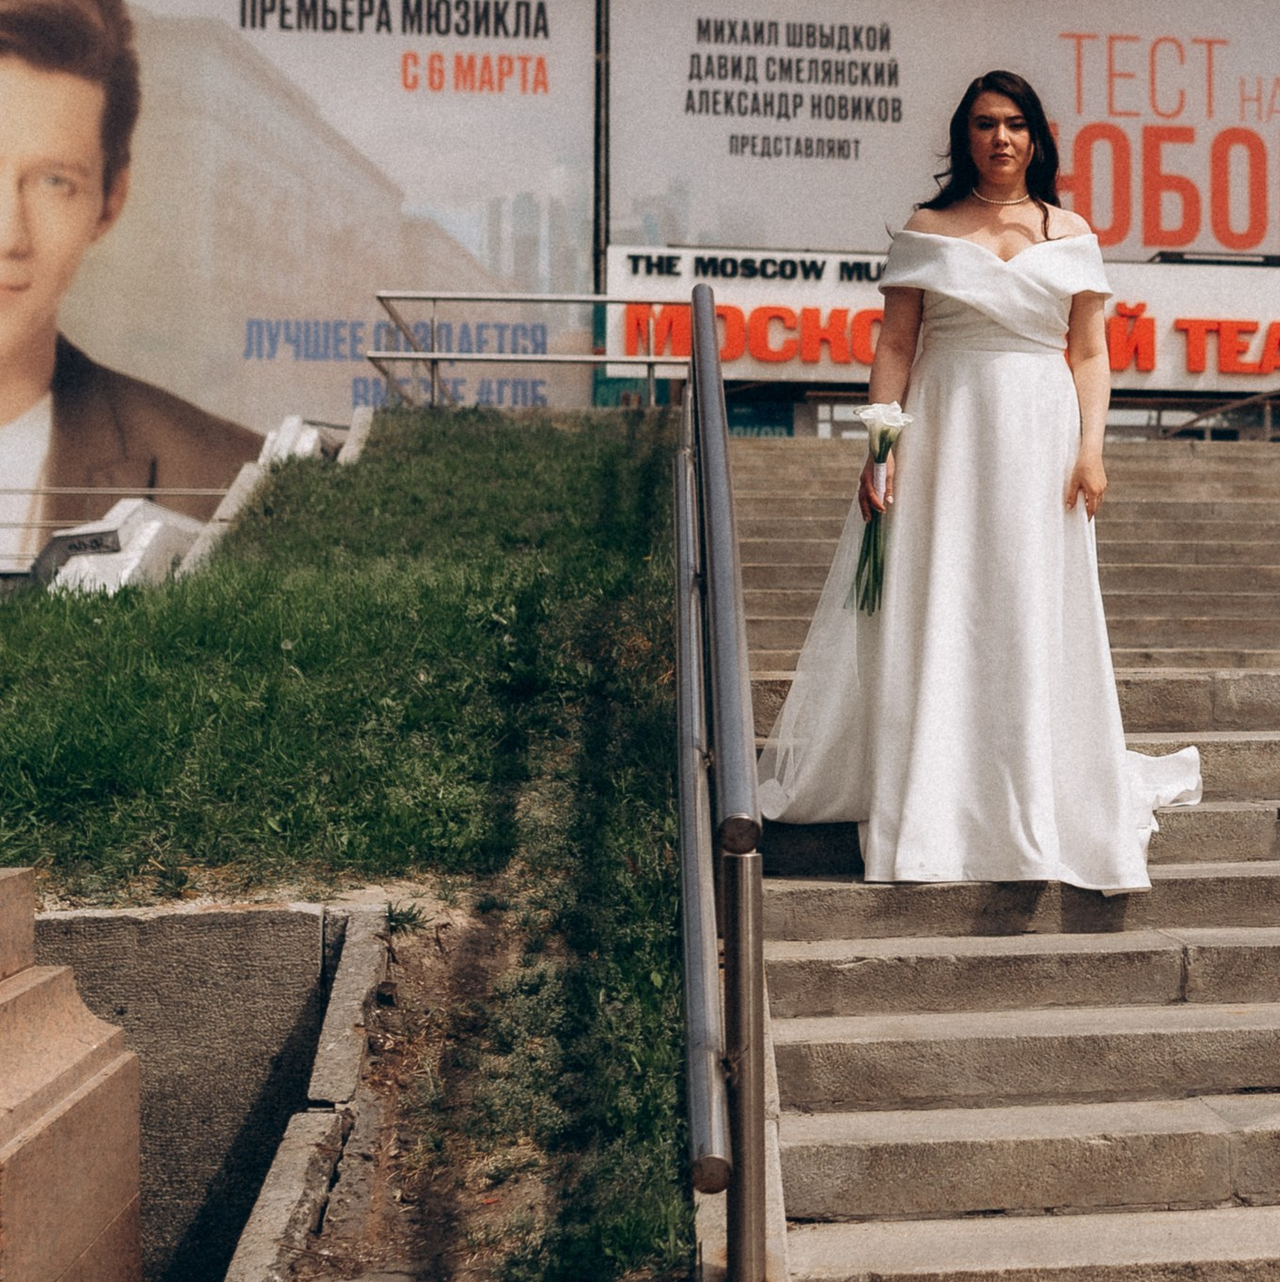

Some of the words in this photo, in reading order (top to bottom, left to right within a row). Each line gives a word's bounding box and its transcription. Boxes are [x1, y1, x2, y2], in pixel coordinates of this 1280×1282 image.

[697, 17, 778, 46] МИХАИЛ
[786, 23, 891, 52] ШВЫДКОЙ
[401, 51, 419, 92] С
[427, 52, 445, 93] 6
[453, 53, 549, 95] МАРТА
[688, 54, 758, 84] ДАВИД
[765, 56, 899, 87] СМЕЛЯНСКИЙ
[1059, 32, 1229, 121] ТЕСТ
[685, 89, 803, 120] АЛЕКСАНДР
[811, 94, 903, 123] НОВИКОВ
[729, 134, 860, 160] ПРЕДСТАВЛЯЮТ
[627, 255, 682, 276] THE
[694, 256, 826, 281] MOSCOW
[244, 319, 366, 361] ЛУЧШЕЕ
